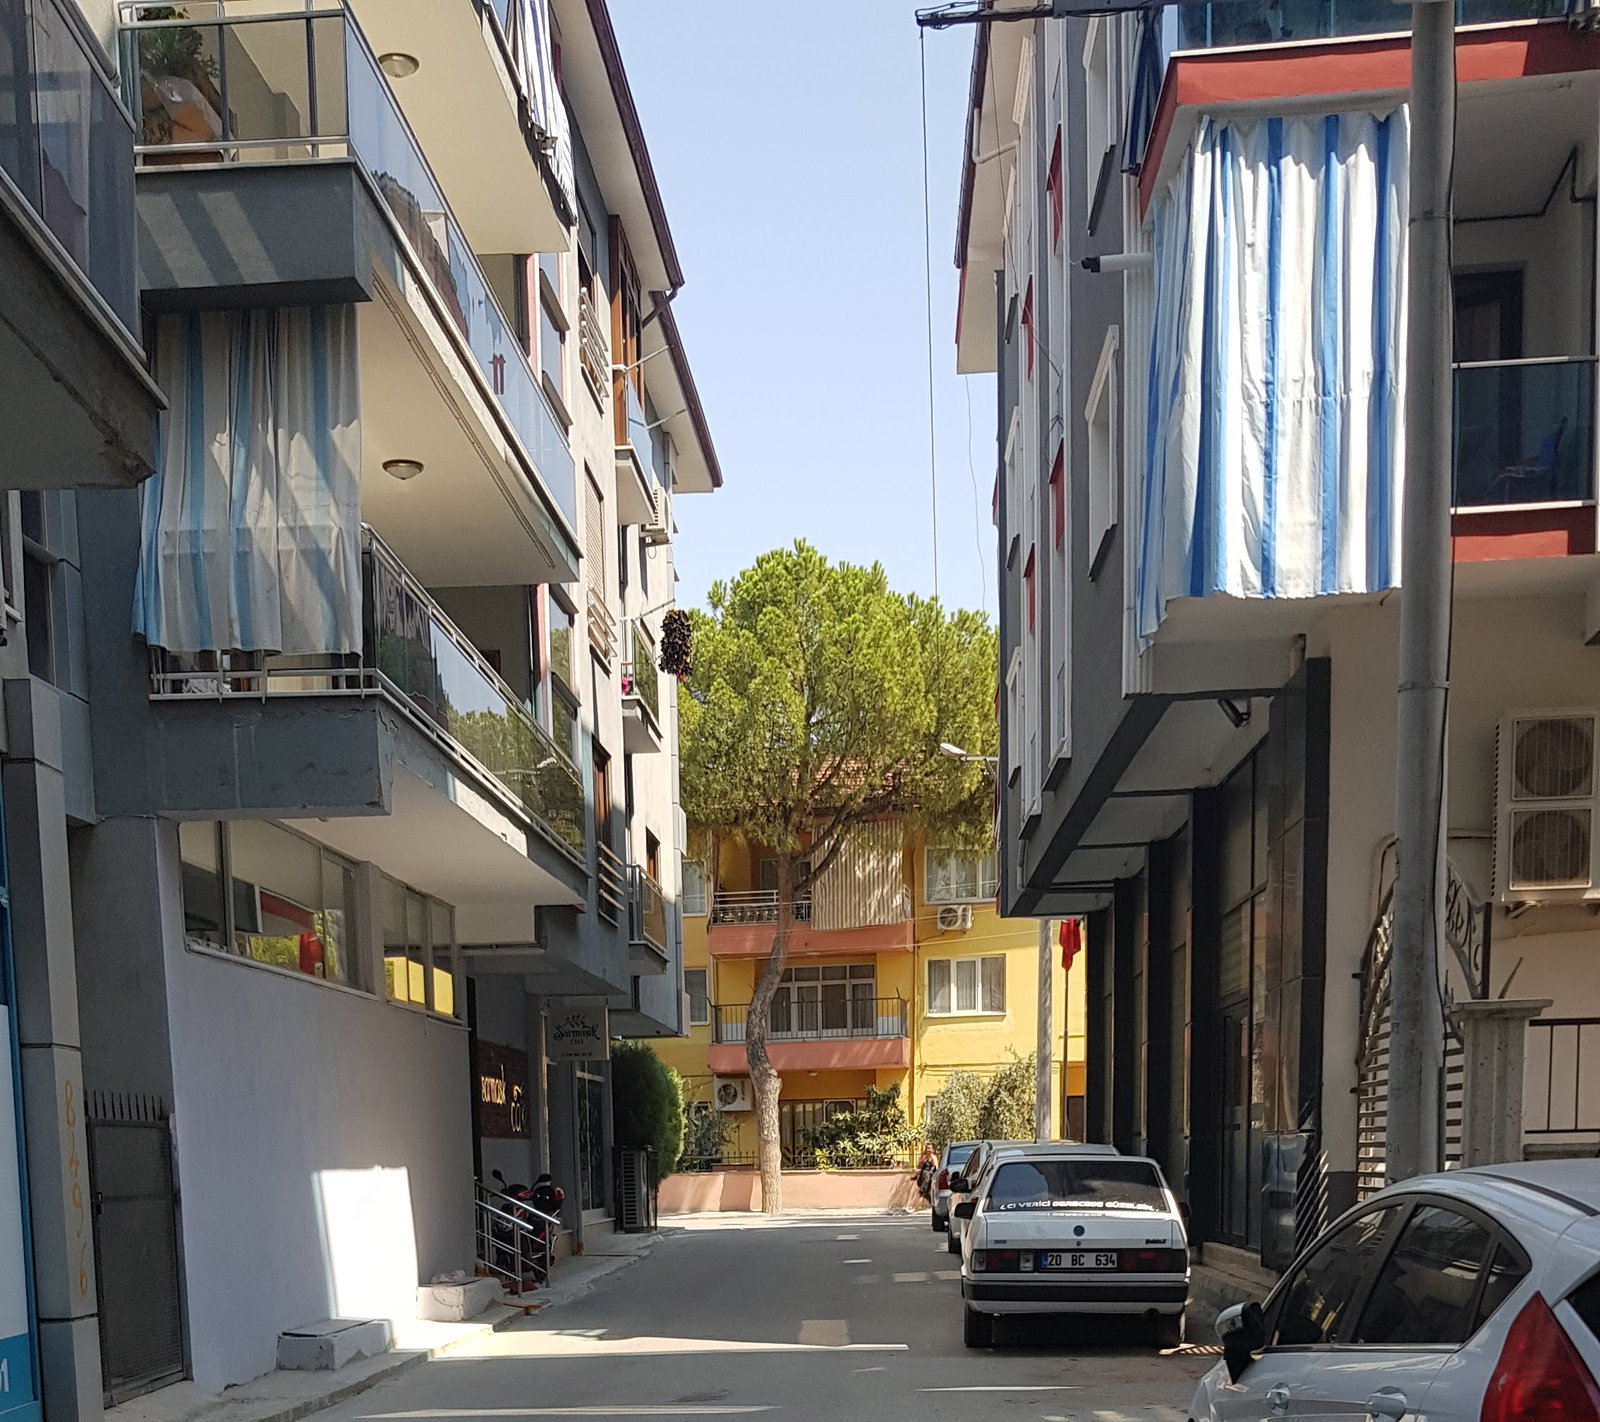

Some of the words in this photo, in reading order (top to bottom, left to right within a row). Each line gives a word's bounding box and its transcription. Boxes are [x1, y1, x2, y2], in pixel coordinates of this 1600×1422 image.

[1048, 1254, 1062, 1266] 20
[1071, 1254, 1085, 1266] BC
[1095, 1254, 1116, 1266] 634
